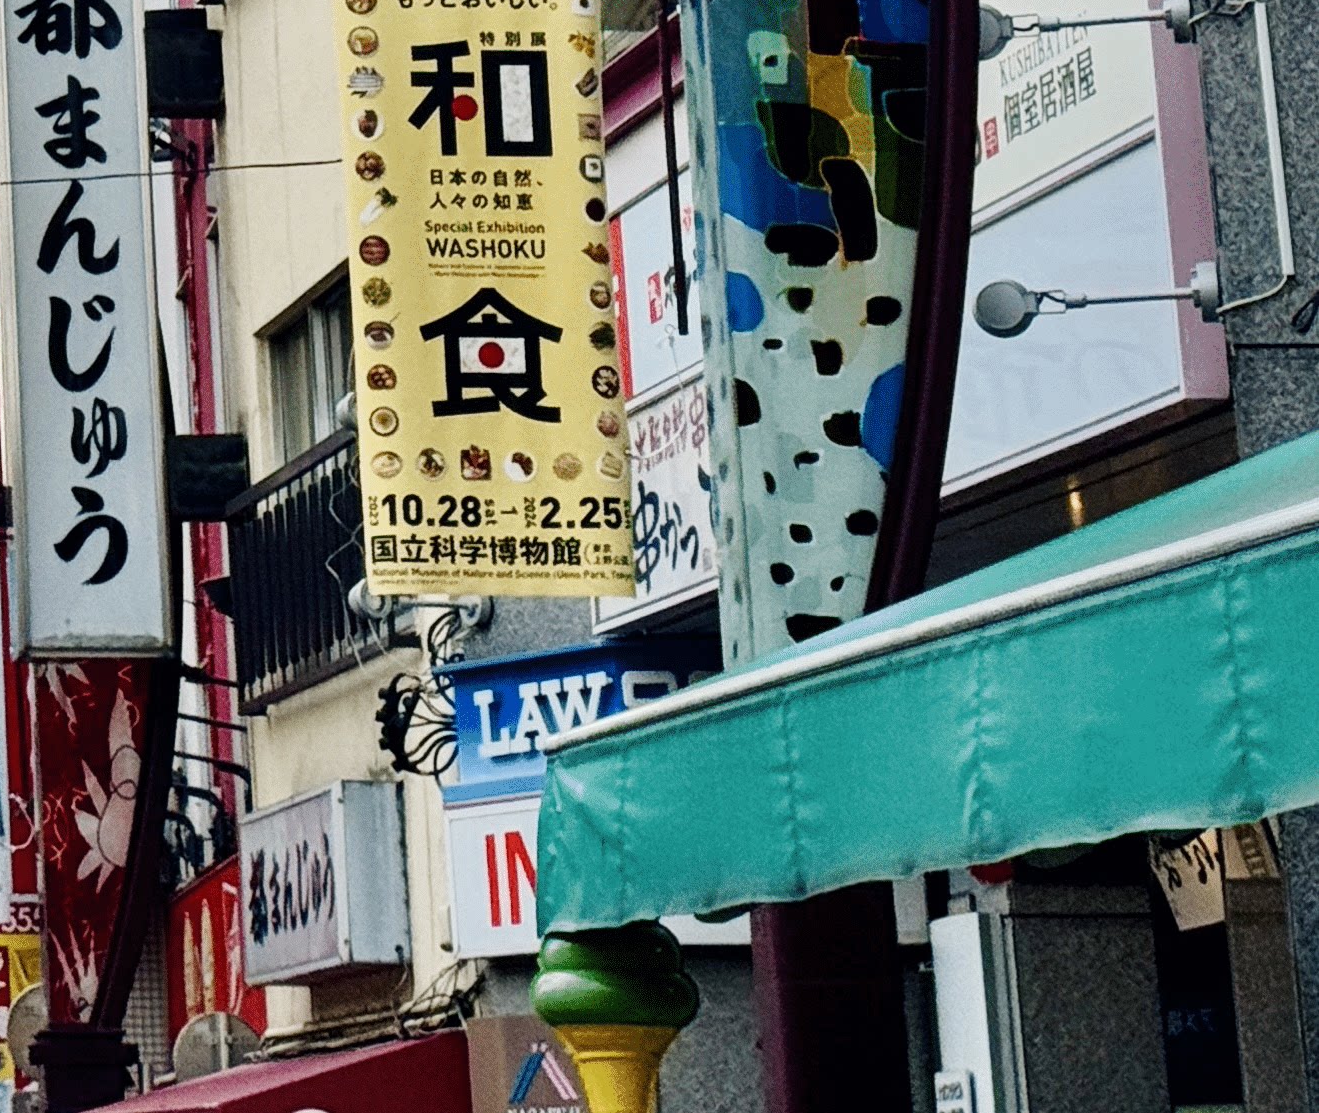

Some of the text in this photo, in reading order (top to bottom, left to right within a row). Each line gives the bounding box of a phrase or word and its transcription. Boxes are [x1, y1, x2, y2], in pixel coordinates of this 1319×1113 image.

[479, 31, 547, 47] 特別展
[407, 39, 554, 158] 和
[1003, 45, 1097, 145] 個室居酒屋
[429, 169, 544, 187] 日本の自然、
[429, 192, 533, 211] 人々の知恵
[424, 220, 546, 235] Special Exhibition
[426, 237, 546, 260] WASHOKU
[419, 287, 564, 424] 食
[381, 493, 482, 529] 10.28
[539, 496, 622, 530] 2.25
[371, 534, 582, 567] 国立科学博物館
